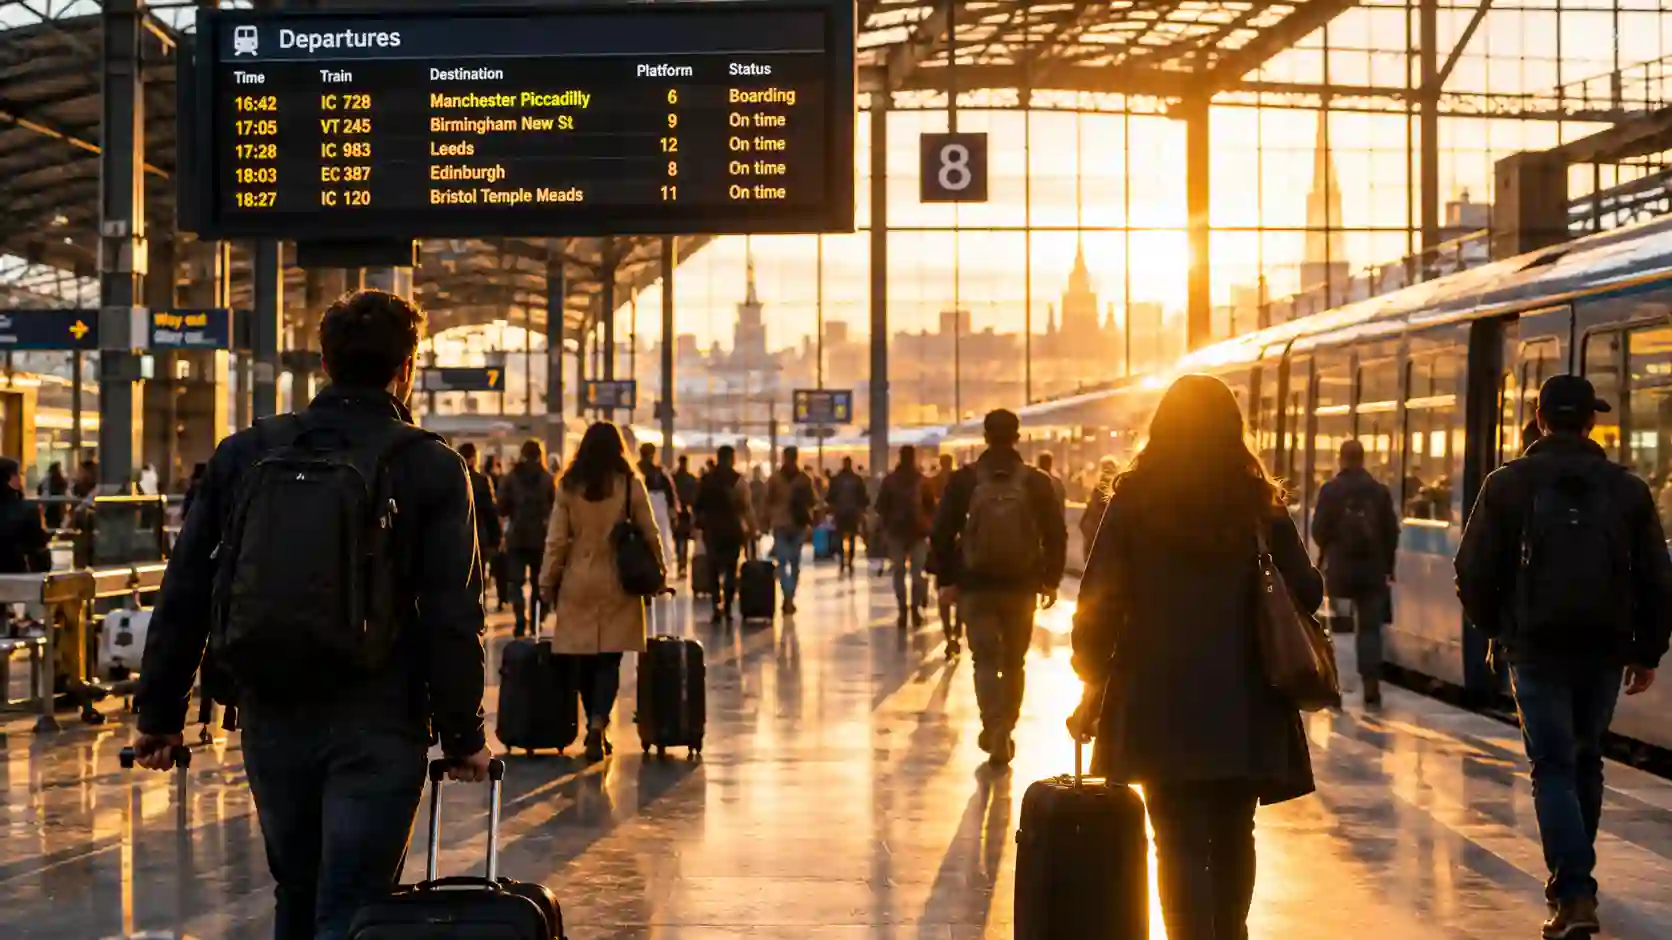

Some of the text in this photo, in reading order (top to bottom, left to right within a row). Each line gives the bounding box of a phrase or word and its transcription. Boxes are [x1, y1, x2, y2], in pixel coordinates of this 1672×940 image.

[279, 28, 401, 54] Departures
[233, 62, 772, 85] Time Train Destination Platform Status
[235, 87, 797, 113] 16:42 IC 728 Manchester Piccadilly 6 Boarding
[235, 111, 787, 136] 17:05 VT 245 Birmingham New St 9 On time
[235, 135, 787, 160] 17:28 IC 983 Leeds 12 On time
[235, 159, 787, 184] 18:03 EC 387 Edinburgh 8 On time
[938, 143, 972, 191] 8
[235, 183, 787, 208] 18:27 IC 120 Bristol Temple Meads 11 On time
[487, 369, 499, 388] 7
